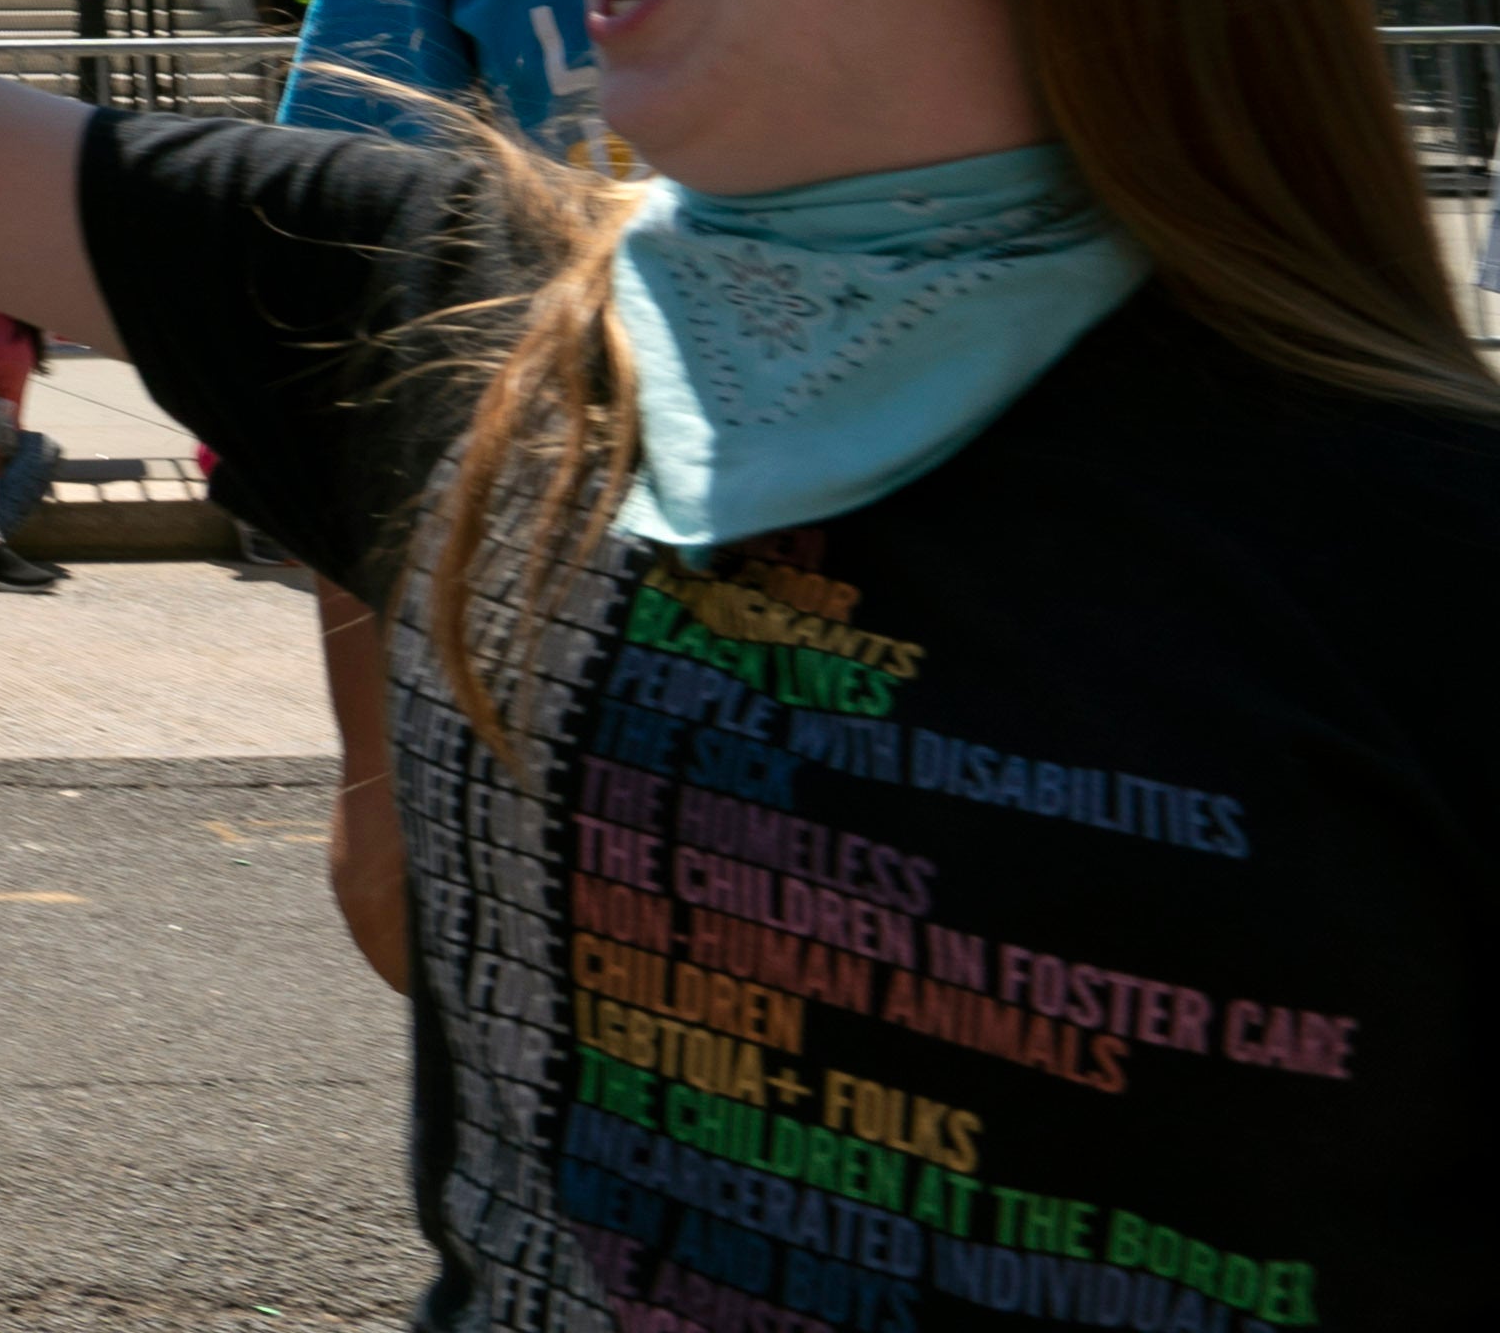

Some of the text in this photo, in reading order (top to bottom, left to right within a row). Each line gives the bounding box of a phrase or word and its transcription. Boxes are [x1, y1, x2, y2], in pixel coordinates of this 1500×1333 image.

[604, 642, 1250, 860] PEOPLE WITH DISABILITIES
[773, 644, 902, 718] LIVES
[578, 752, 673, 833] THE
[677, 783, 940, 919] HOMELESS
[568, 869, 875, 1016] NON-HUMAN
[879, 965, 1130, 1095] ANIMALS
[571, 811, 1360, 1080] THE CHILDREN IN FOSTER CARE
[571, 930, 806, 1056] CHILDREN
[573, 988, 986, 1174] LGBTQIA+ FOLKS
[574, 1044, 660, 1130] THE
[663, 1082, 910, 1214] CHILDREN
[912, 1163, 983, 1237] AT
[991, 1185, 1098, 1259] THE
[563, 1101, 928, 1281] INCARCERATED
